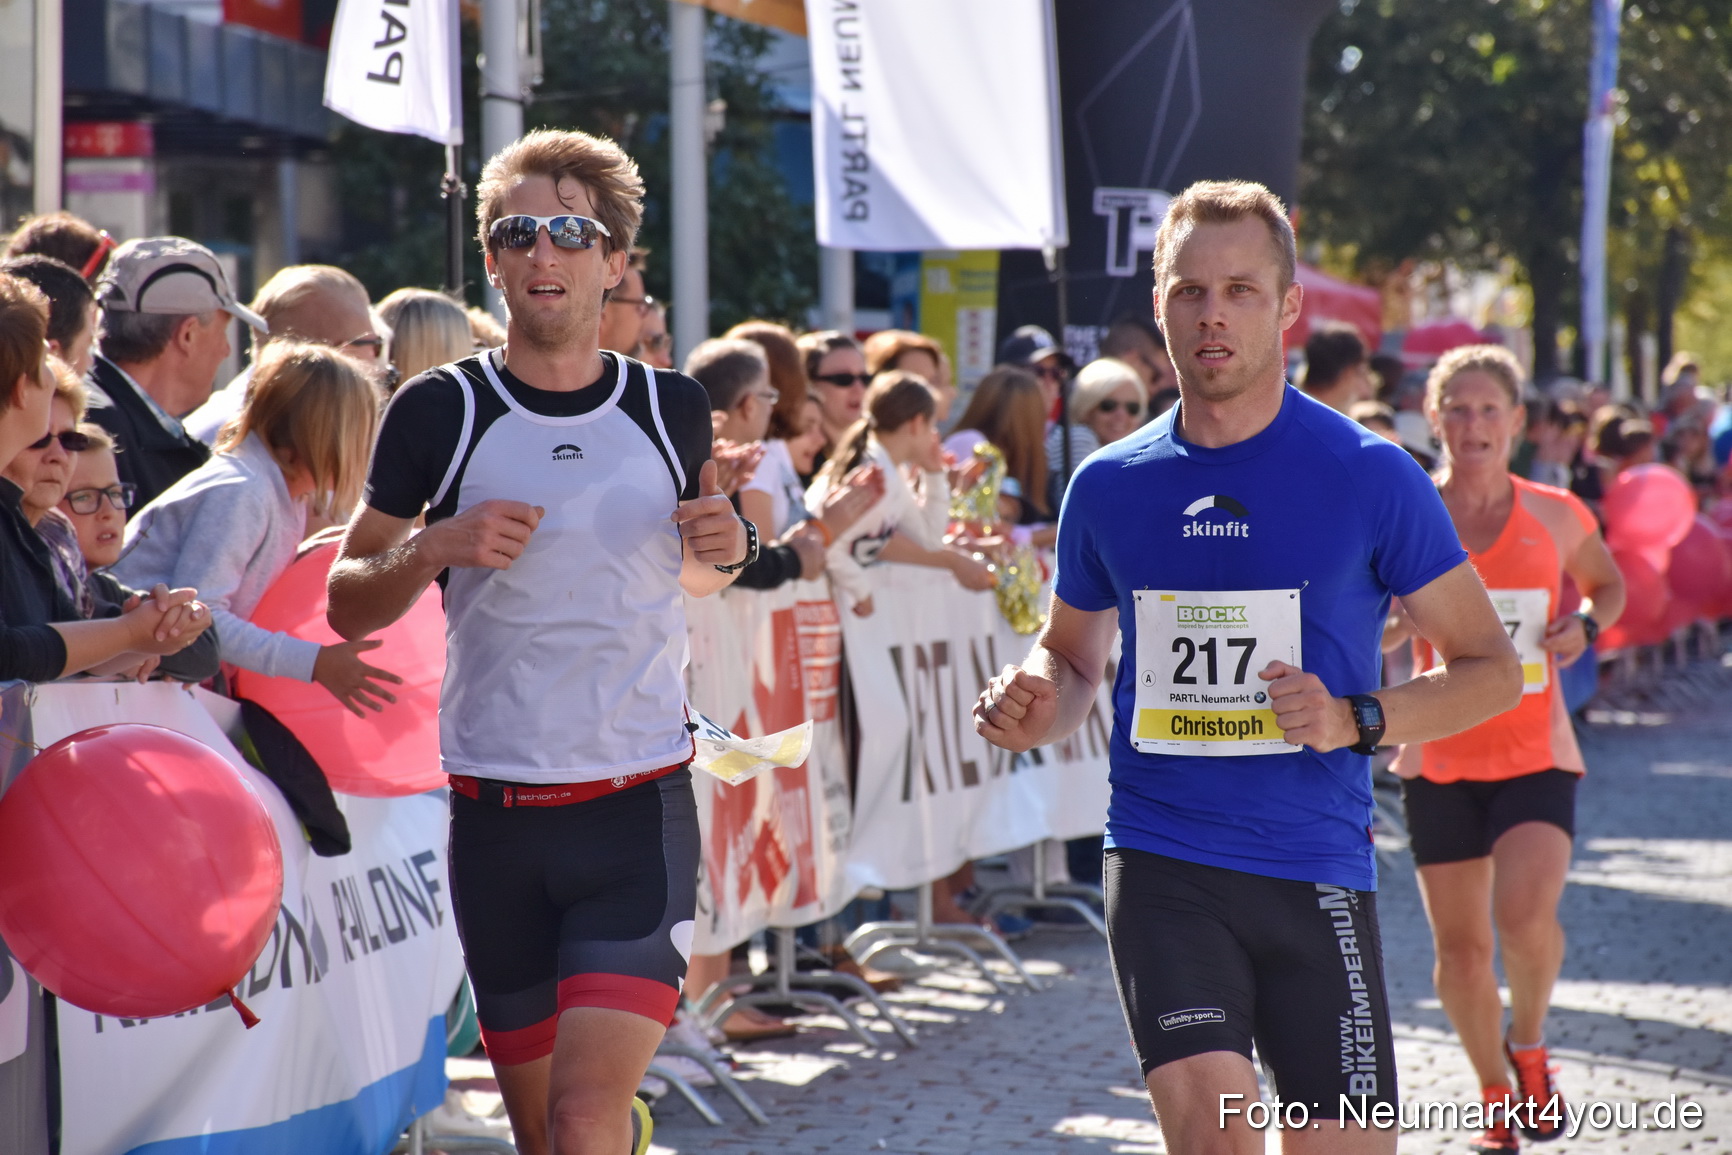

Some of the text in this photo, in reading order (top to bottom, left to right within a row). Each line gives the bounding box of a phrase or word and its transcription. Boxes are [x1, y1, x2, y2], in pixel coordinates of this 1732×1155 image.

[552, 453, 584, 461] skinfit
[1183, 521, 1249, 538] skinfit
[1177, 606, 1248, 622] BOCK
[1171, 637, 1257, 685] 217
[1169, 693, 1250, 704] PARTL Neumarkt
[1171, 715, 1264, 740] Christoph
[1315, 882, 1378, 1097] BIKEIMPERIUM
[1340, 1010, 1355, 1074] www.
